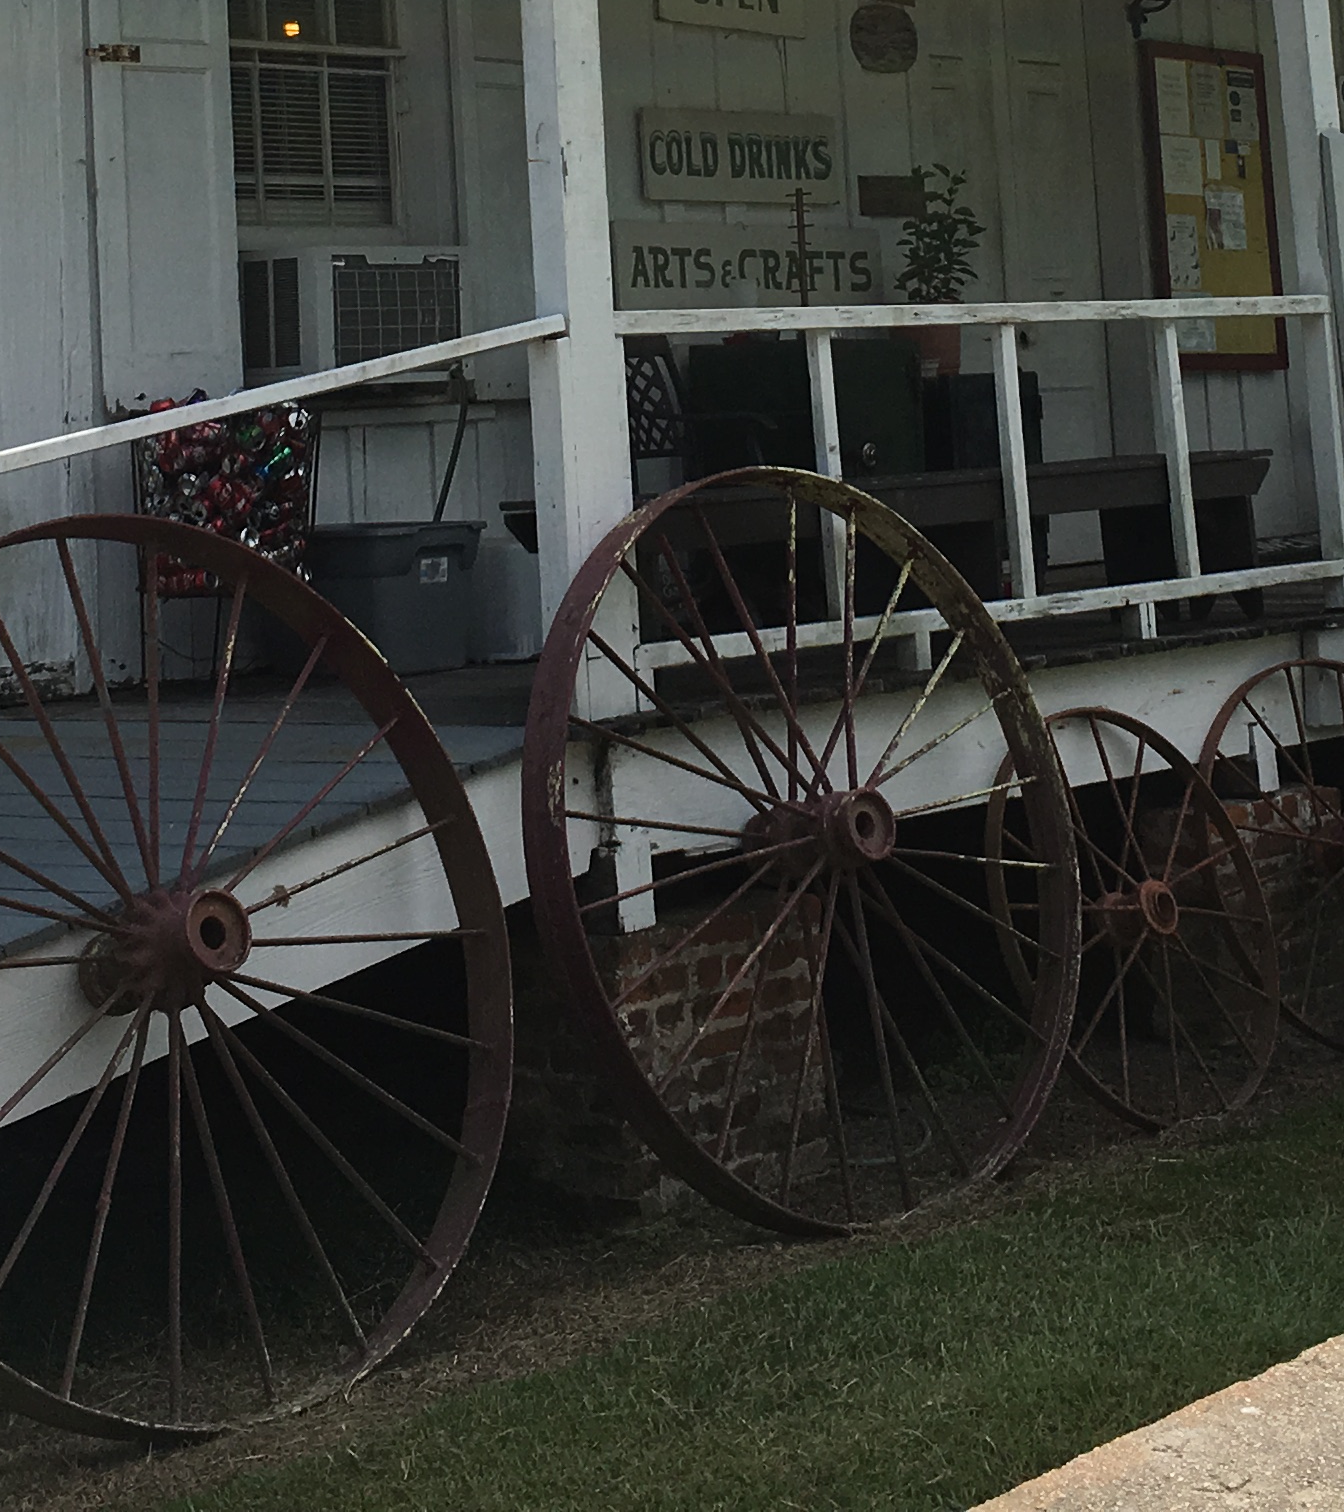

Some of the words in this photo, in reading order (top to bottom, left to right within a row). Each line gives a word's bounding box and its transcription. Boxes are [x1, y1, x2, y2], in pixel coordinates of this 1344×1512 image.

[649, 129, 719, 179] COLD
[728, 132, 834, 181] DRINKS
[630, 245, 716, 290] ARTS
[739, 247, 873, 293] CRAFTS
